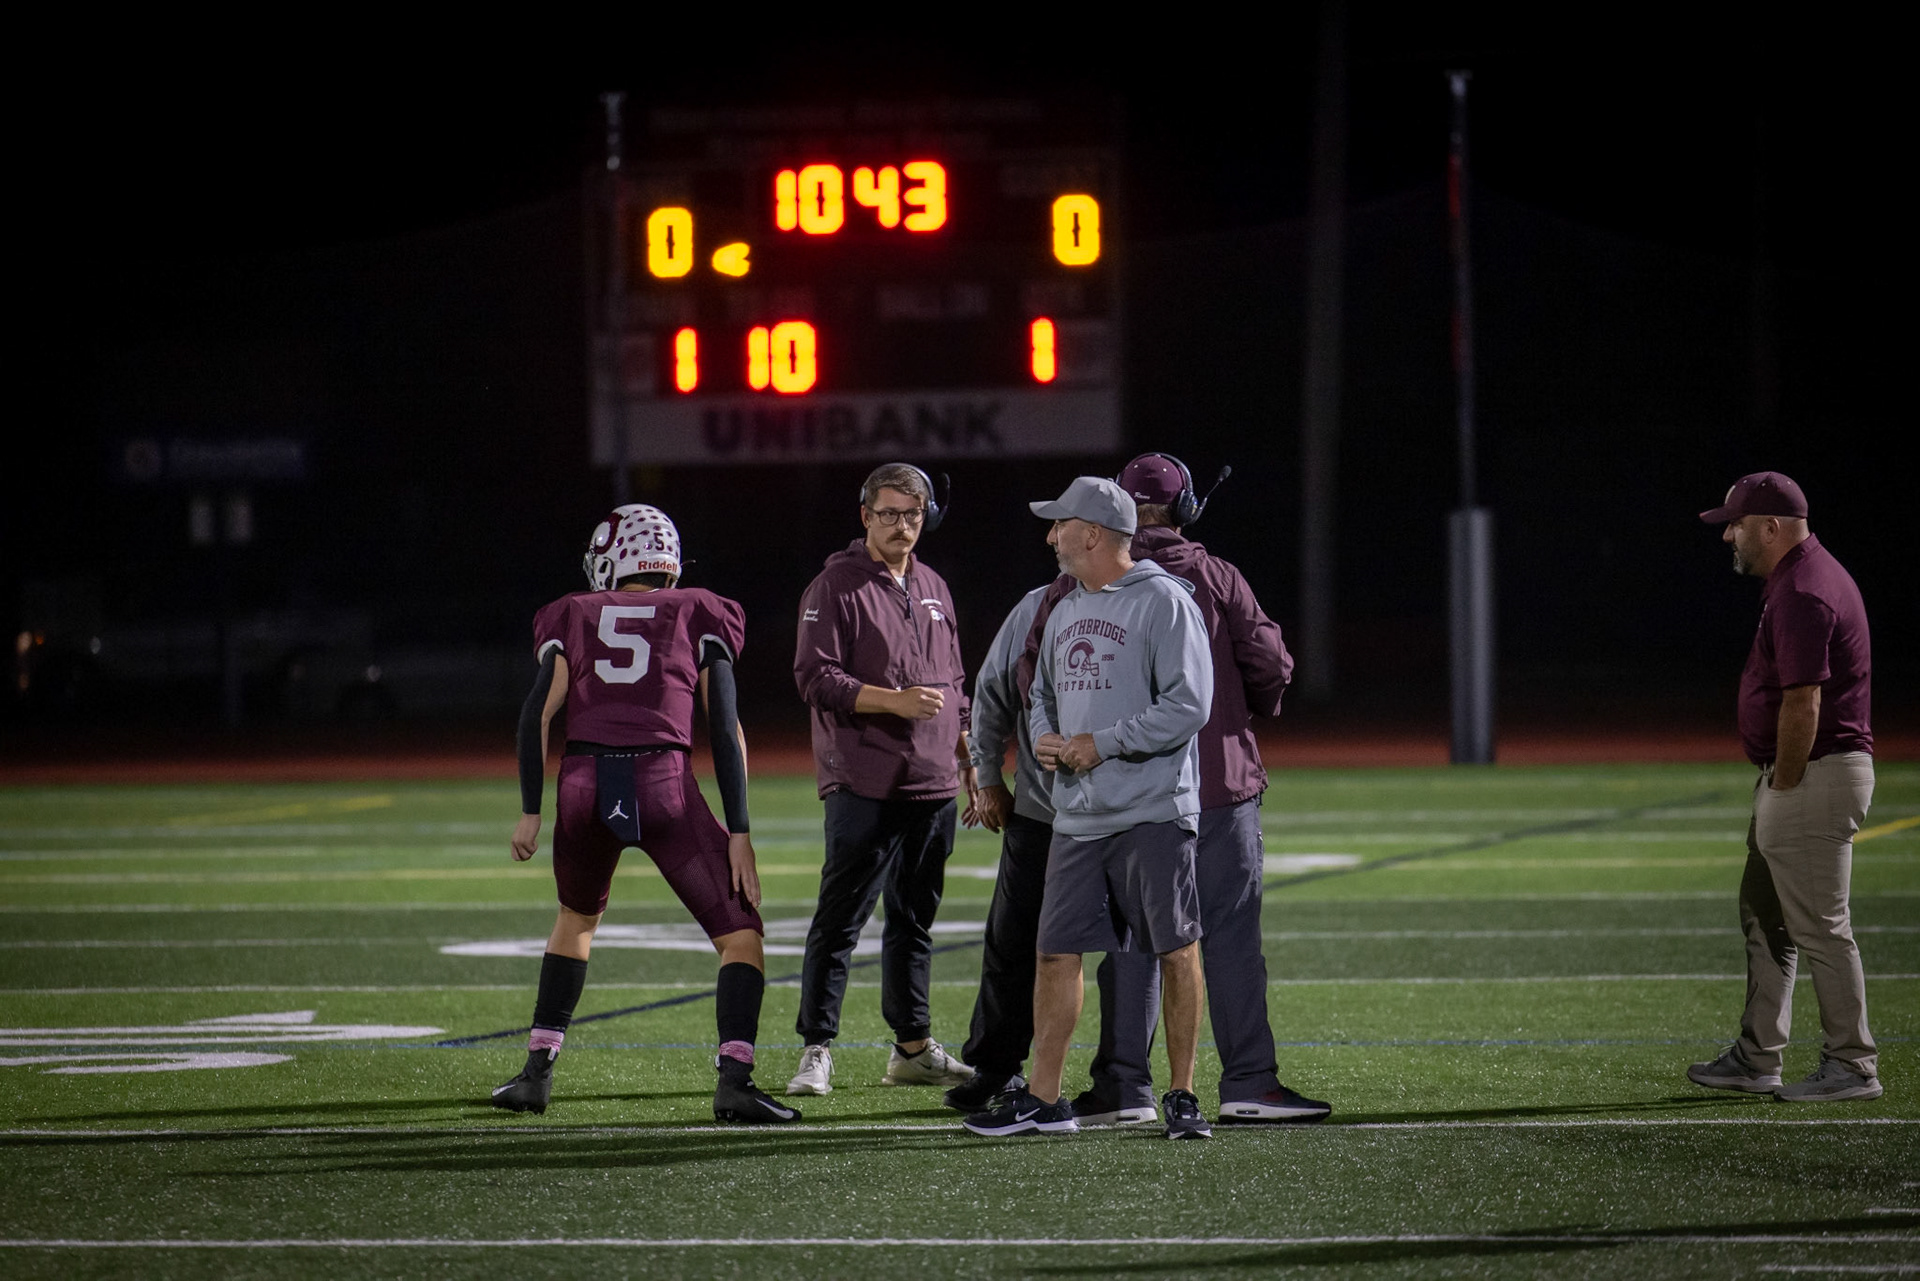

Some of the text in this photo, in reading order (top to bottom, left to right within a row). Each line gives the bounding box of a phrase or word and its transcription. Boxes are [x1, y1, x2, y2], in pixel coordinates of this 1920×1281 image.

[648, 207, 693, 278] 0
[1052, 194, 1100, 265] 0
[675, 327, 697, 392] 1
[748, 321, 816, 393] 10
[1031, 317, 1055, 383] 1
[702, 403, 1001, 452] UNIBANK
[638, 560, 678, 574] Riddell
[654, 532, 665, 551] 5
[595, 605, 656, 684] 5
[1055, 618, 1127, 652] NORTHBRIDGE
[1057, 679, 1112, 693] FOTBALL
